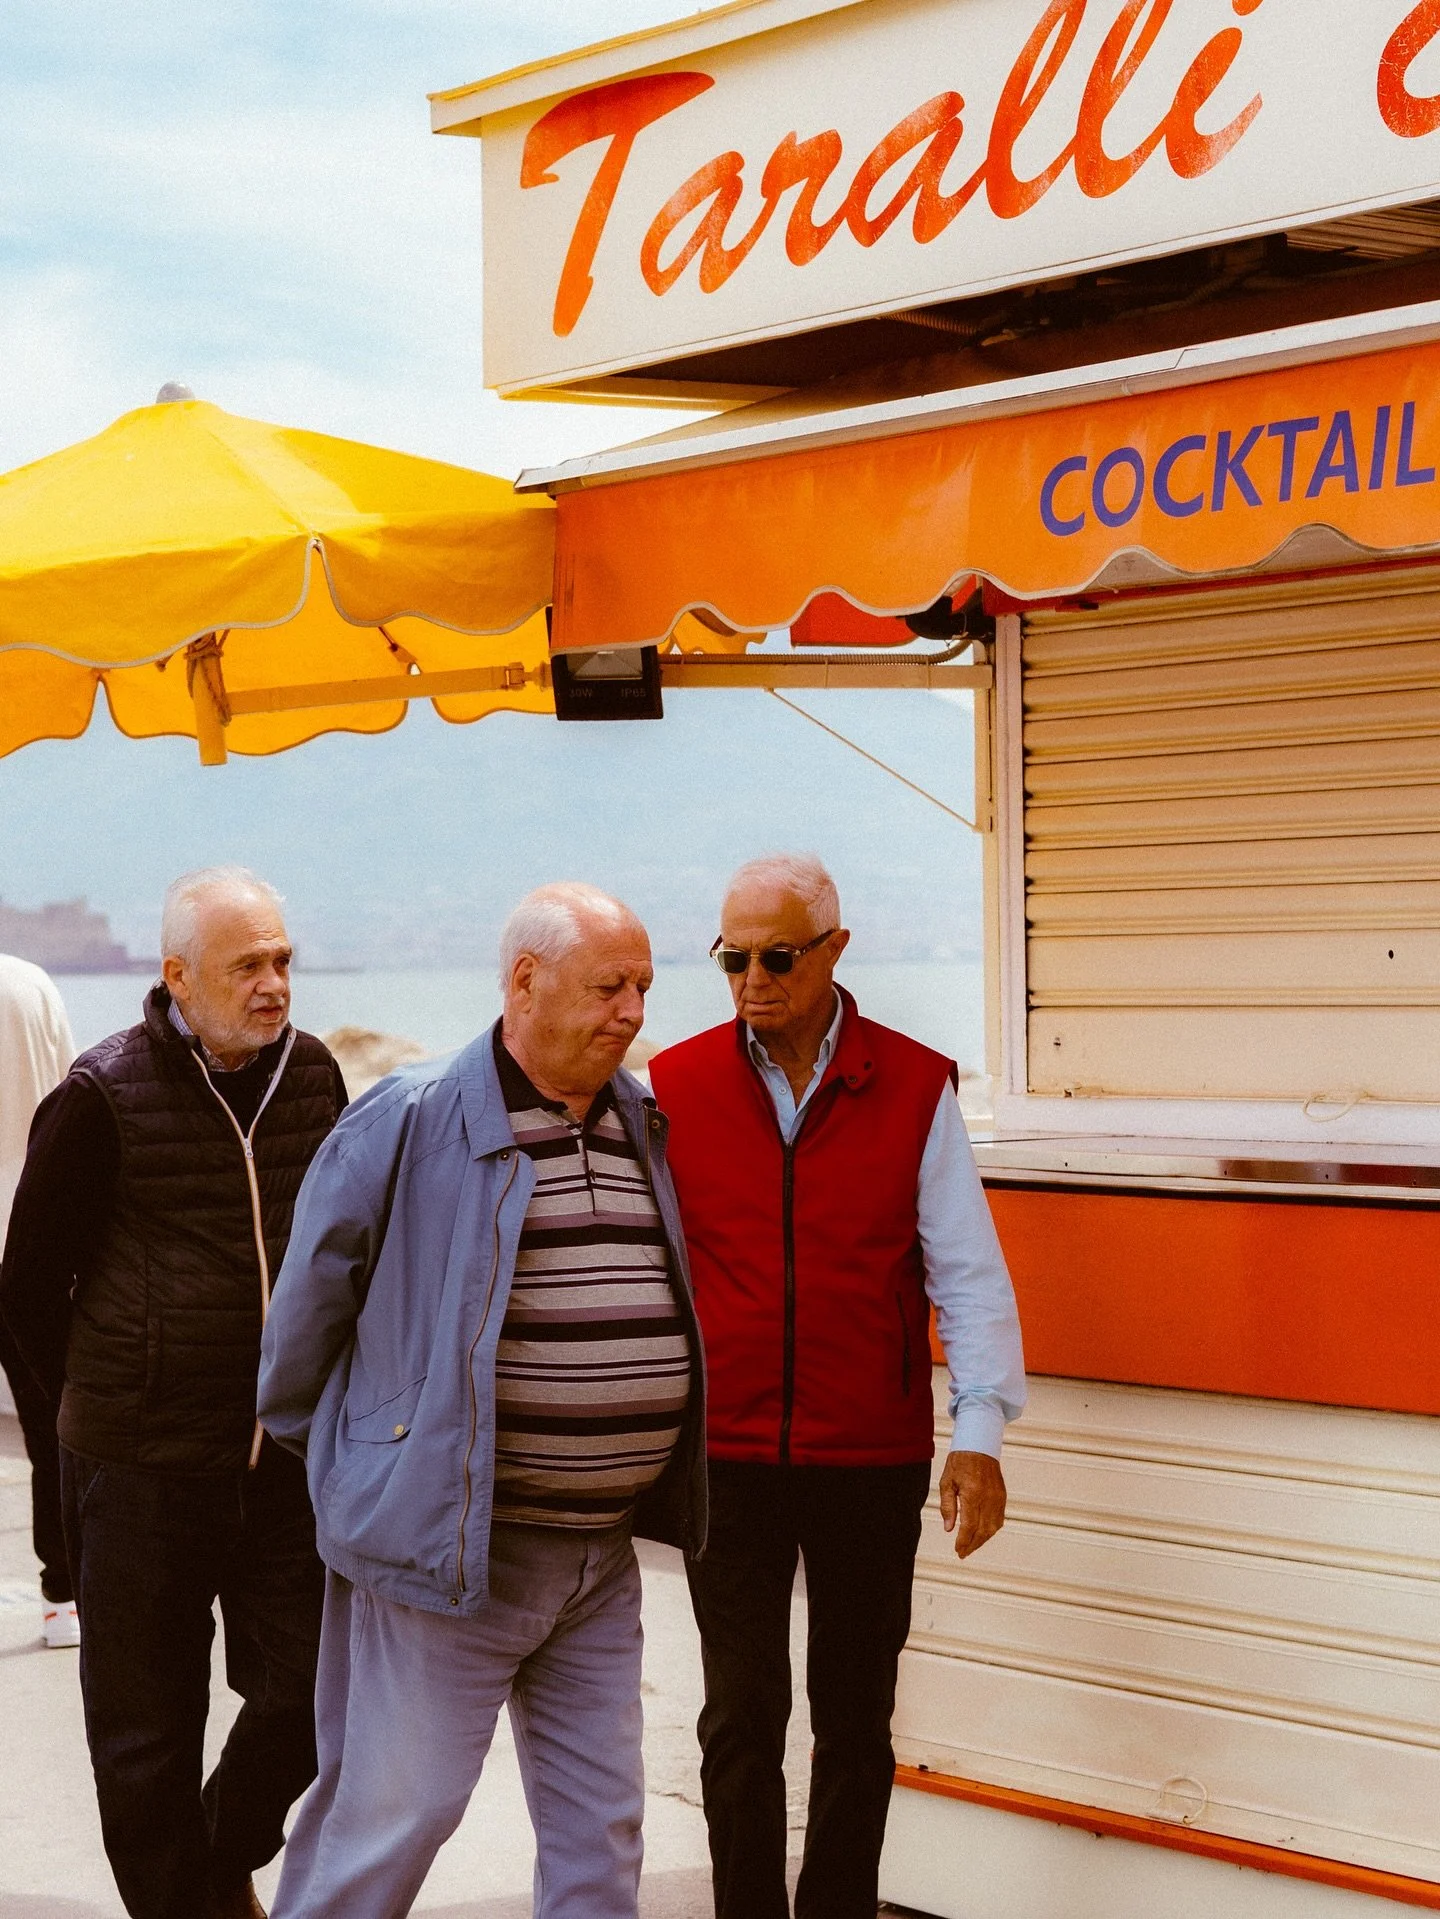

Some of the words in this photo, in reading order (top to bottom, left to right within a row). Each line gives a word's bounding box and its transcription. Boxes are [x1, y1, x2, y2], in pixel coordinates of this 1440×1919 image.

[520, 0, 1263, 337] Taralli
[1040, 402, 1435, 536] COCKTAIL
[621, 687, 647, 698] IP65
